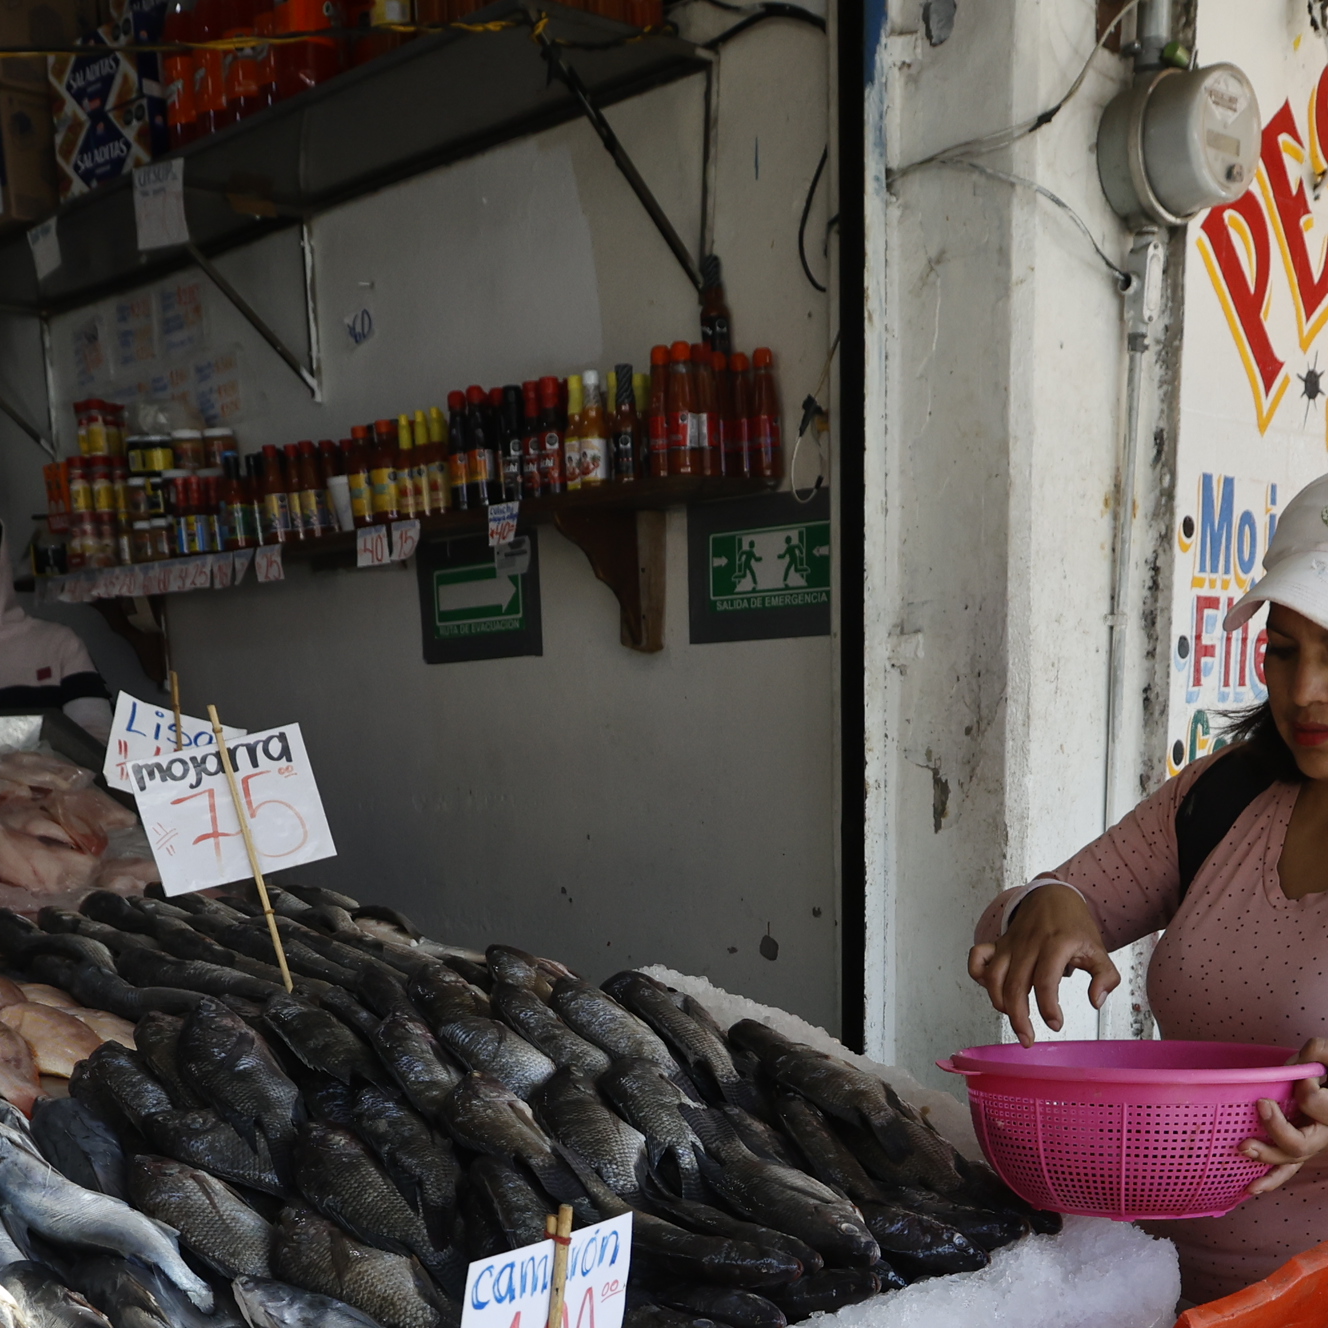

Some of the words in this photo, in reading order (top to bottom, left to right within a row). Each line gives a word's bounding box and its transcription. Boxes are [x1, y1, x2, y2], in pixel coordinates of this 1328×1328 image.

[68, 53, 119, 89] SALADITAS
[75, 137, 129, 173] SALADITAS
[716, 598, 750, 611] SALIDA
[751, 597, 764, 608] DE
[765, 591, 829, 607] EMERGENCIA
[132, 731, 293, 793] mojarra
